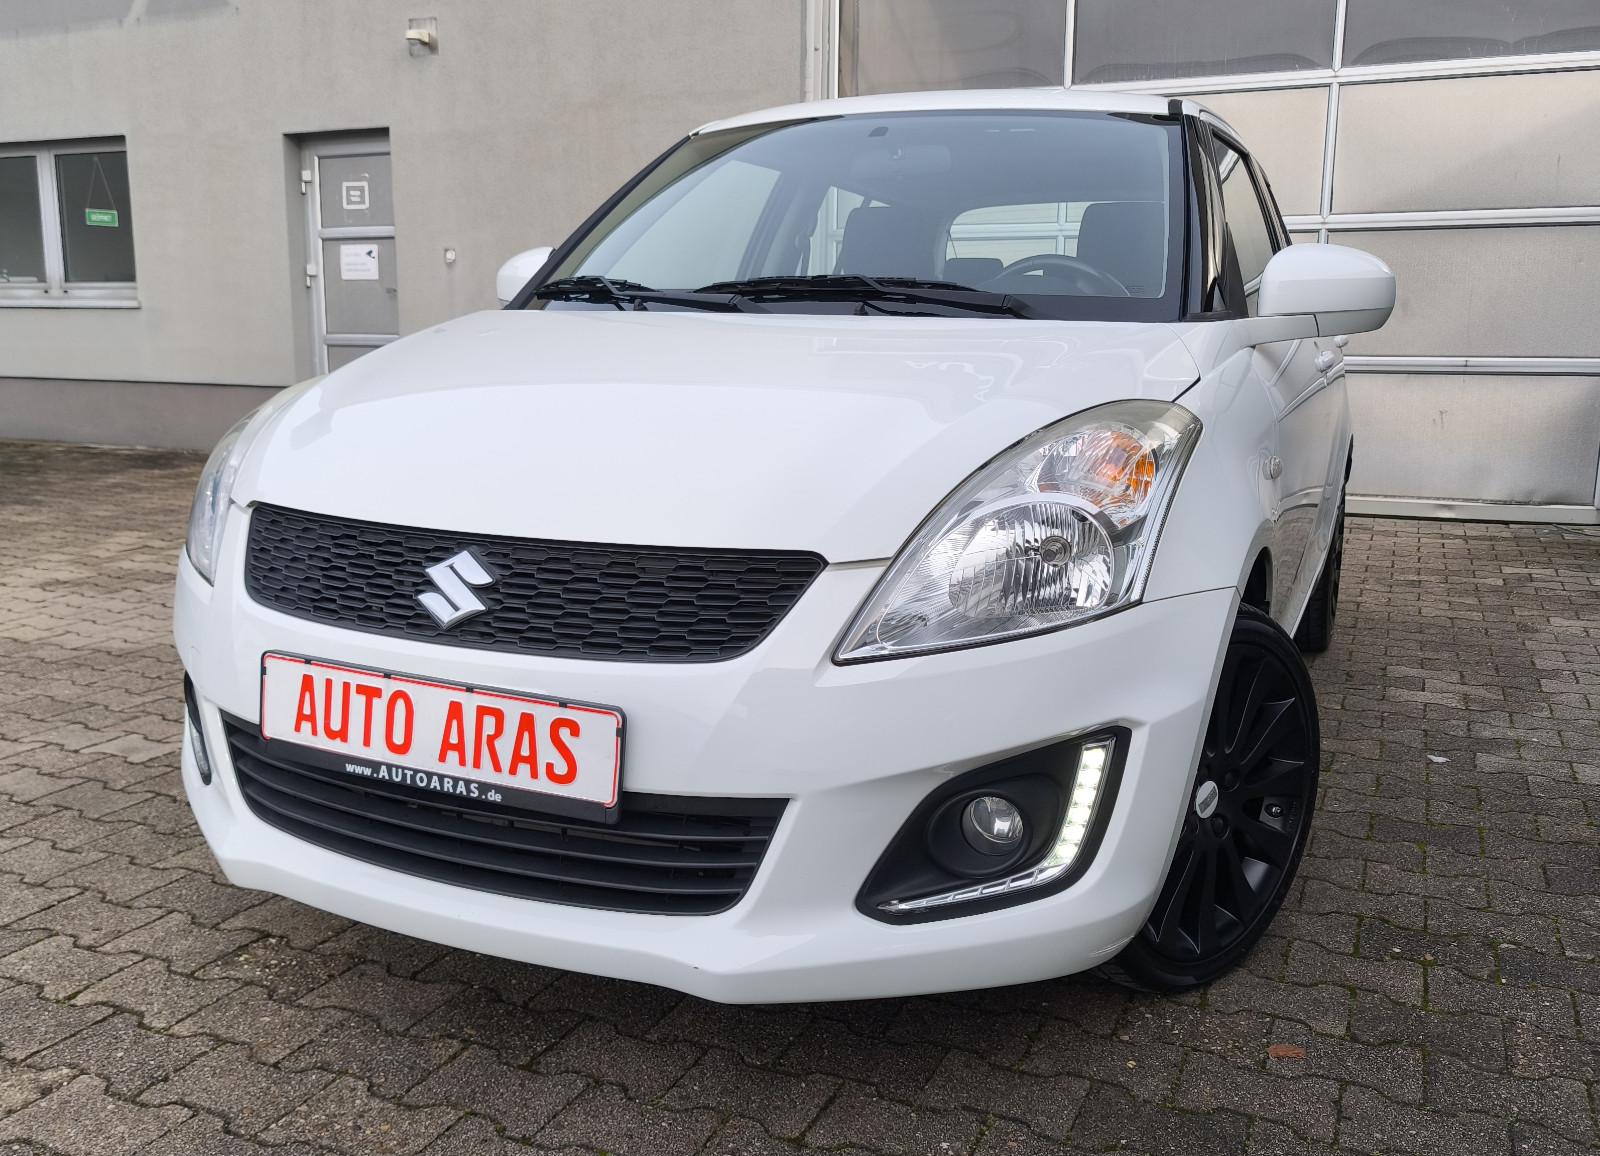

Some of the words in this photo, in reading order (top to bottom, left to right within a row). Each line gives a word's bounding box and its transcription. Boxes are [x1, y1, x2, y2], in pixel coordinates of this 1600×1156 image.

[294, 673, 415, 756] AUTO
[438, 700, 581, 786] ARAS
[344, 762, 503, 803] www.AUTOARAS.de
